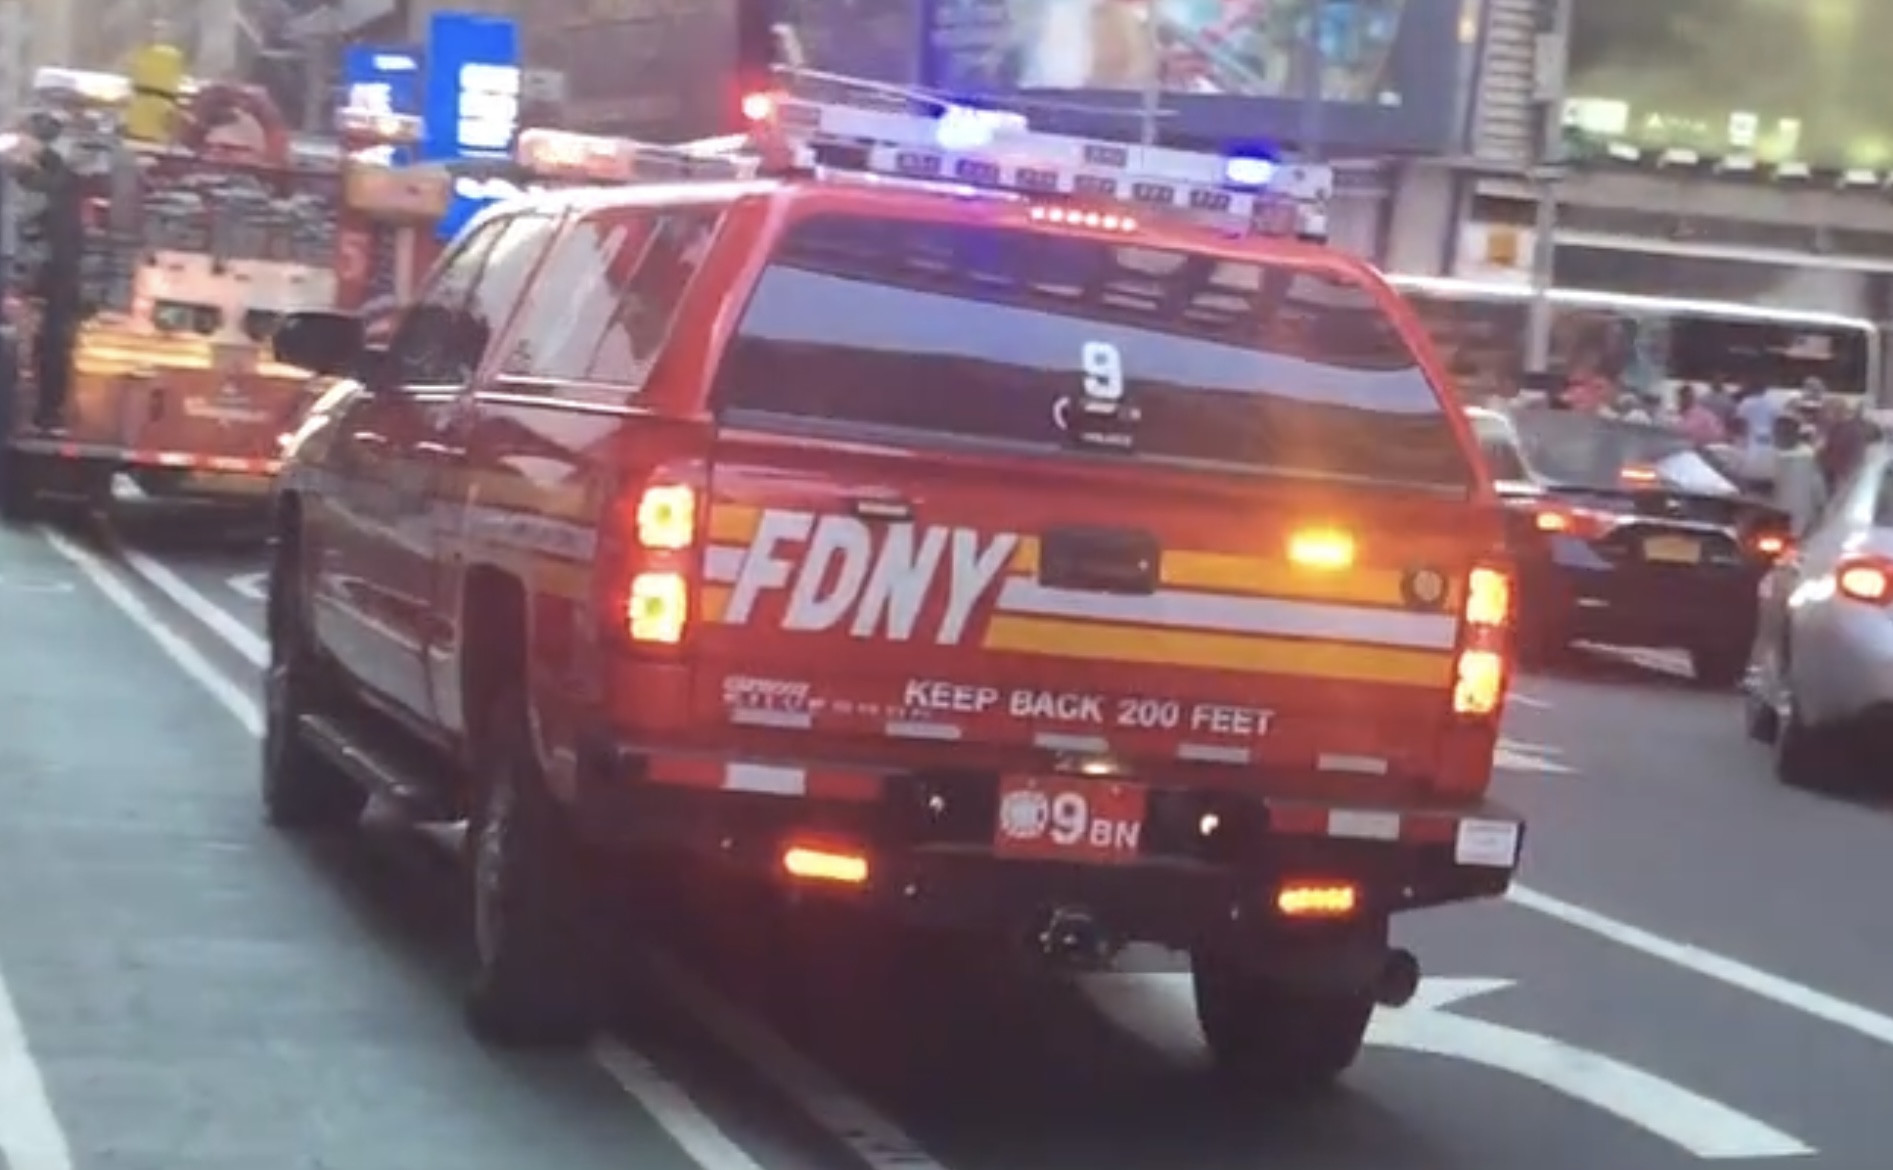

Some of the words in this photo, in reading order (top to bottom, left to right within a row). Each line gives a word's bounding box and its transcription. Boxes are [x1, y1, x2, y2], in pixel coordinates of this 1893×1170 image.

[1082, 340, 1123, 399] 9
[722, 508, 1018, 645] FDNY
[904, 678, 998, 712] KEEP
[1009, 688, 1104, 723] BACK
[1117, 699, 1179, 728] 200
[1190, 704, 1275, 736] FEET
